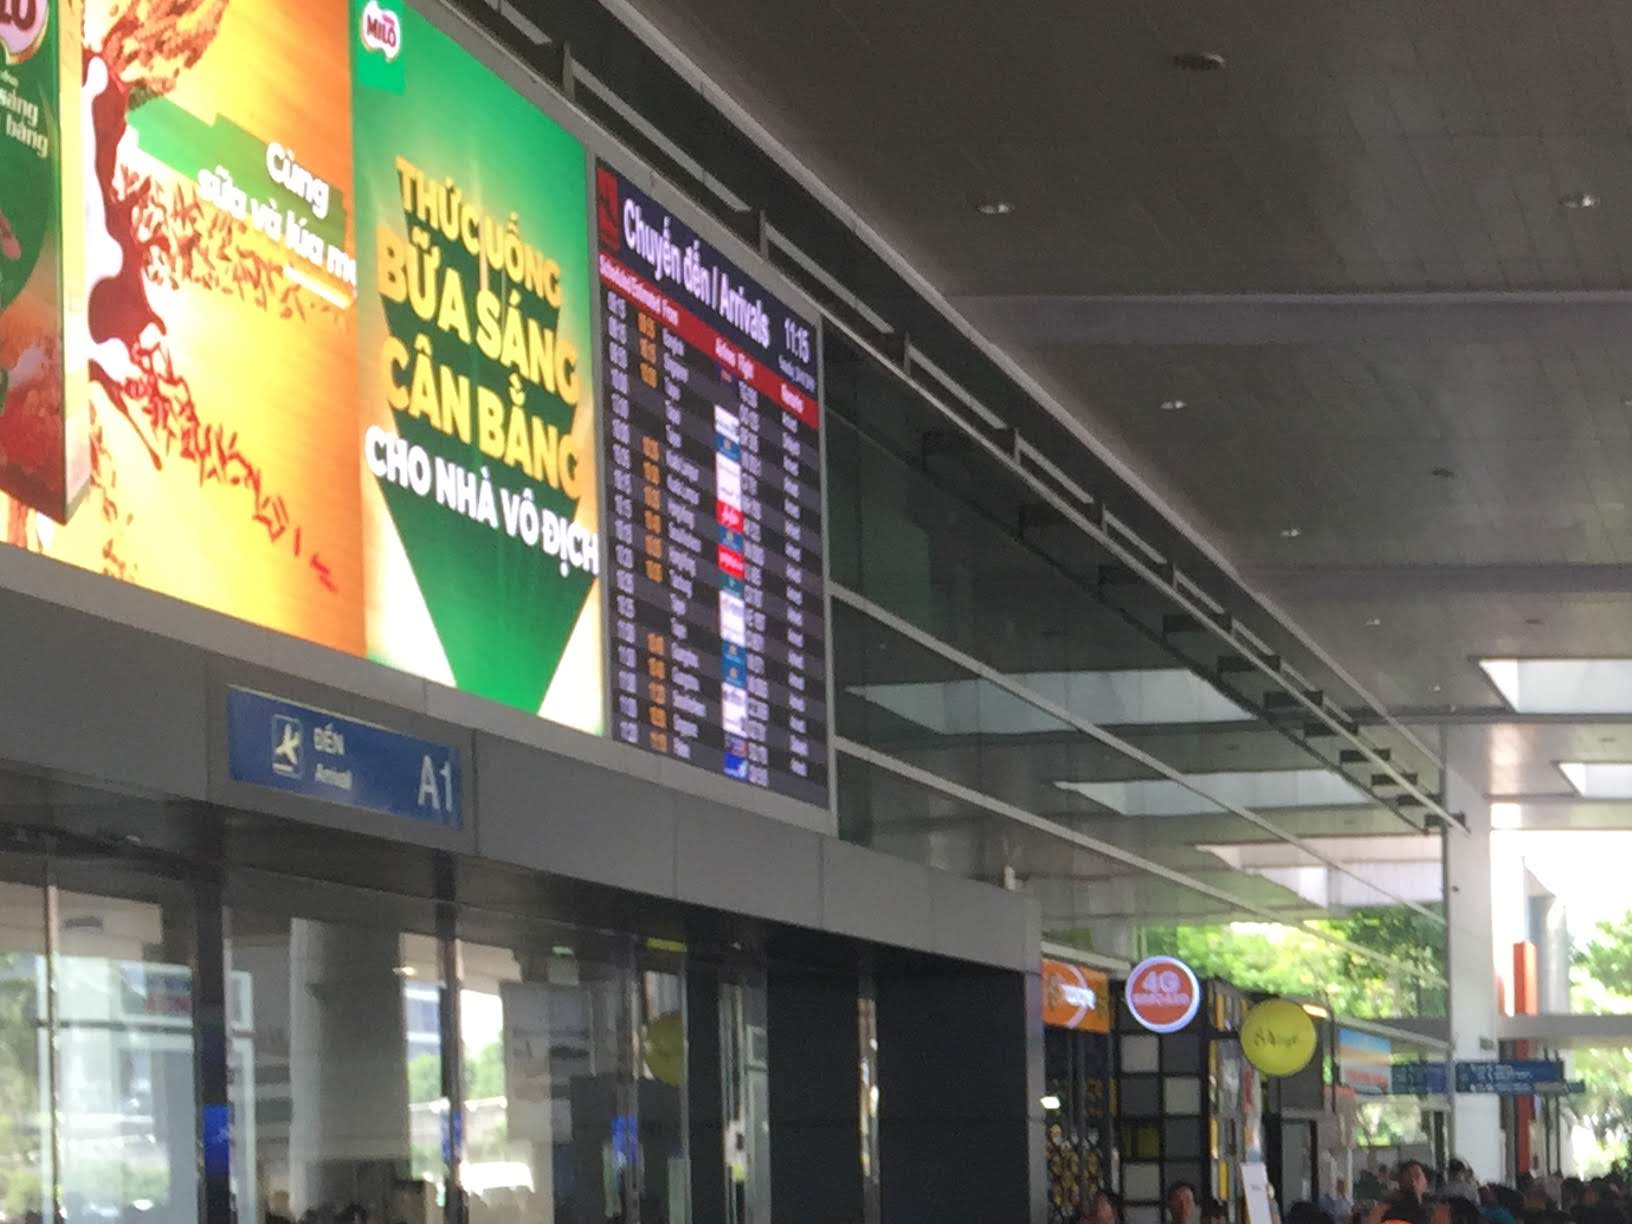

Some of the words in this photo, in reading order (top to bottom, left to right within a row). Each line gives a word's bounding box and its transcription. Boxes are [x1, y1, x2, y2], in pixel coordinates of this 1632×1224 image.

[250, 198, 282, 241] và
[286, 210, 325, 267] lúa
[266, 142, 330, 220] Cùng
[396, 155, 480, 257] THỨC
[484, 211, 562, 308] UỐNG
[376, 223, 471, 344] BỮA
[476, 289, 580, 404] SÁNG
[623, 198, 681, 281] Chuyến
[683, 240, 710, 307] đến
[719, 274, 771, 350] Arrivals
[784, 317, 811, 364] 11:15
[382, 333, 472, 444] CÂN
[477, 372, 582, 500] BẰNG
[364, 424, 432, 497] CHO
[435, 457, 499, 530] NHÀ
[500, 487, 540, 547] VÔ
[542, 509, 600, 578] ĐỊCH
[417, 755, 454, 813] A1
[1141, 970, 1182, 994] 4G
